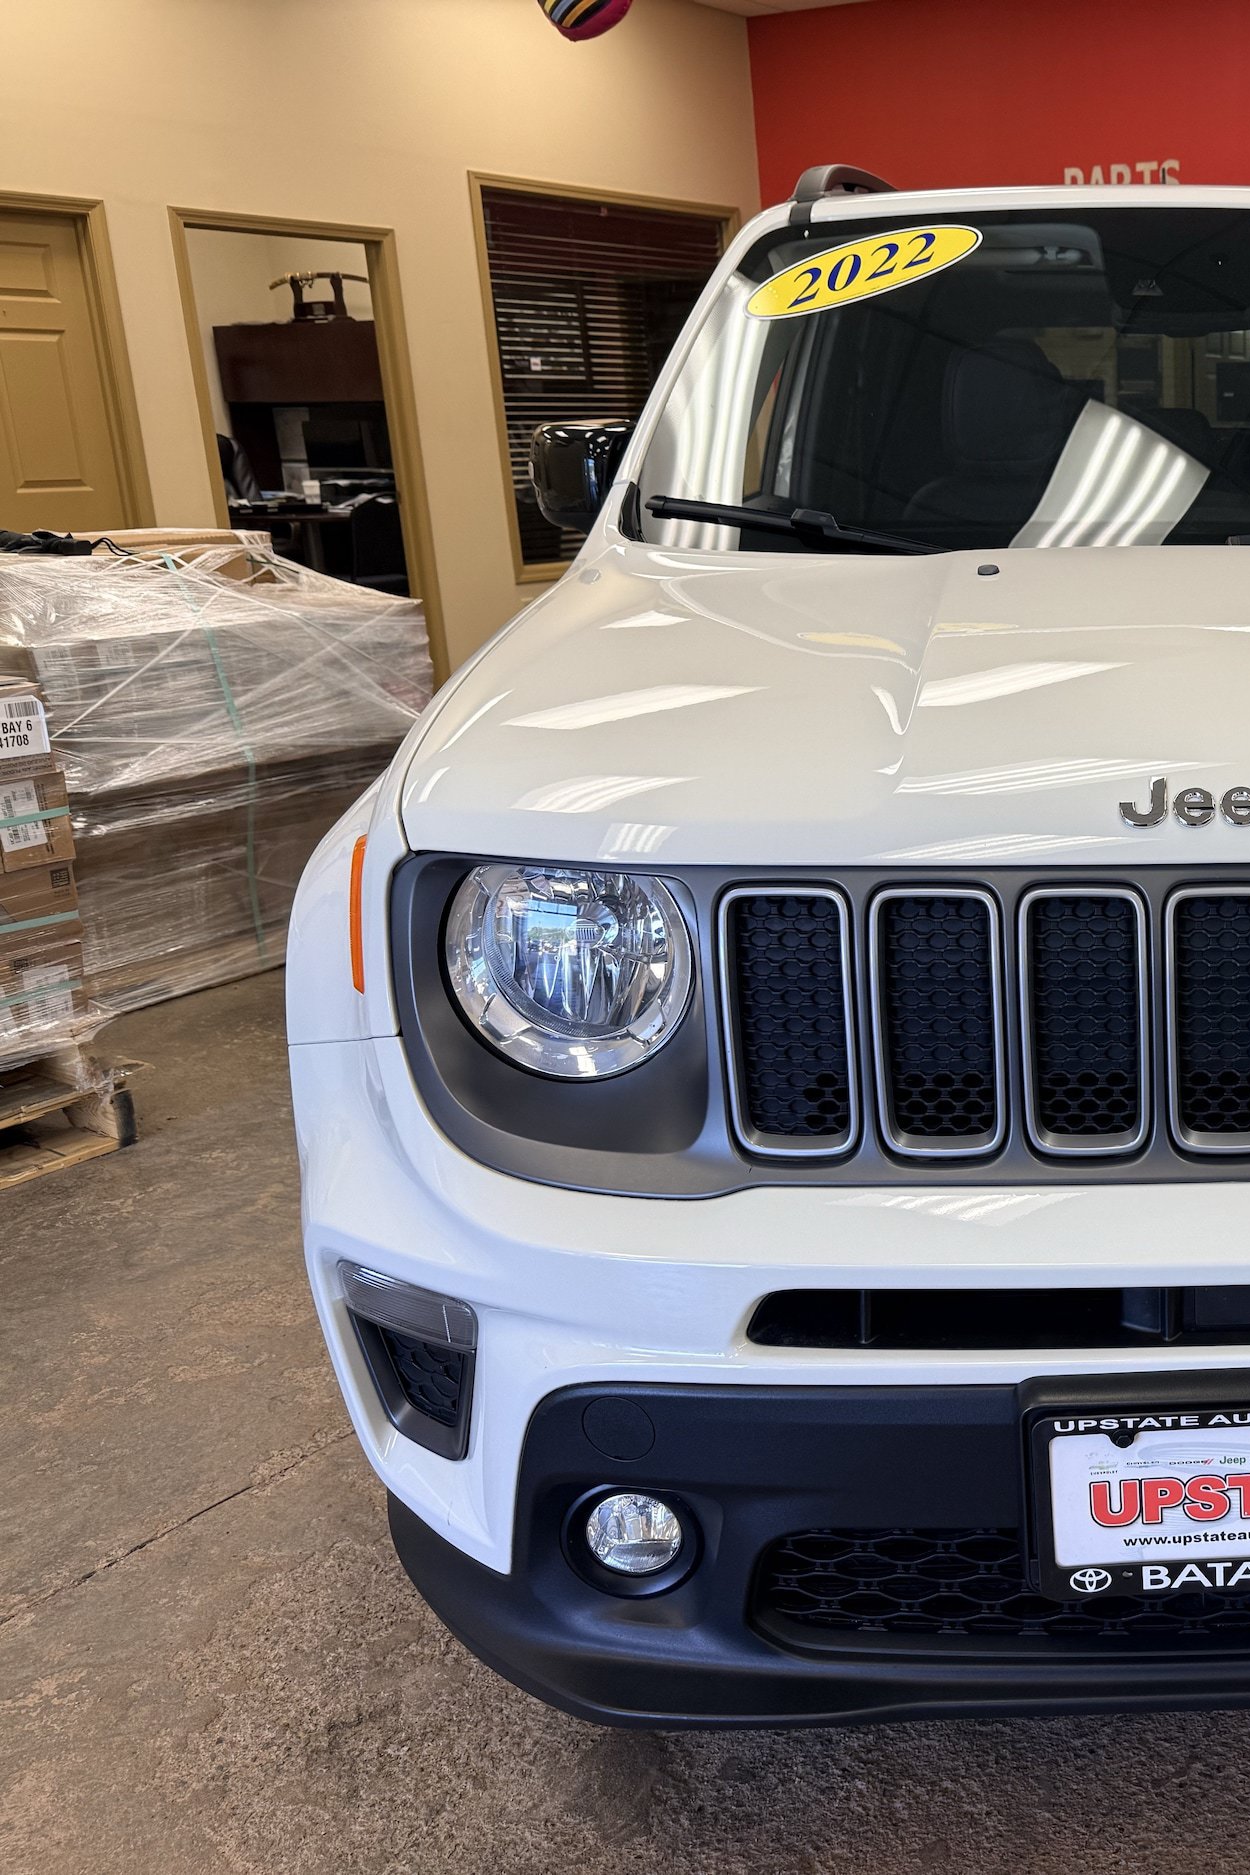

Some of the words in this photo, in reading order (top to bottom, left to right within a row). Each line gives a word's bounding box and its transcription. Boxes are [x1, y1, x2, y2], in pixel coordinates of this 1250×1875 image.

[787, 233, 936, 309] 2022
[2, 720, 22, 734] BAY
[26, 719, 33, 732] 6
[1054, 1415, 1200, 1432] UPSTATE
[1219, 1456, 1247, 1466] Jeep
